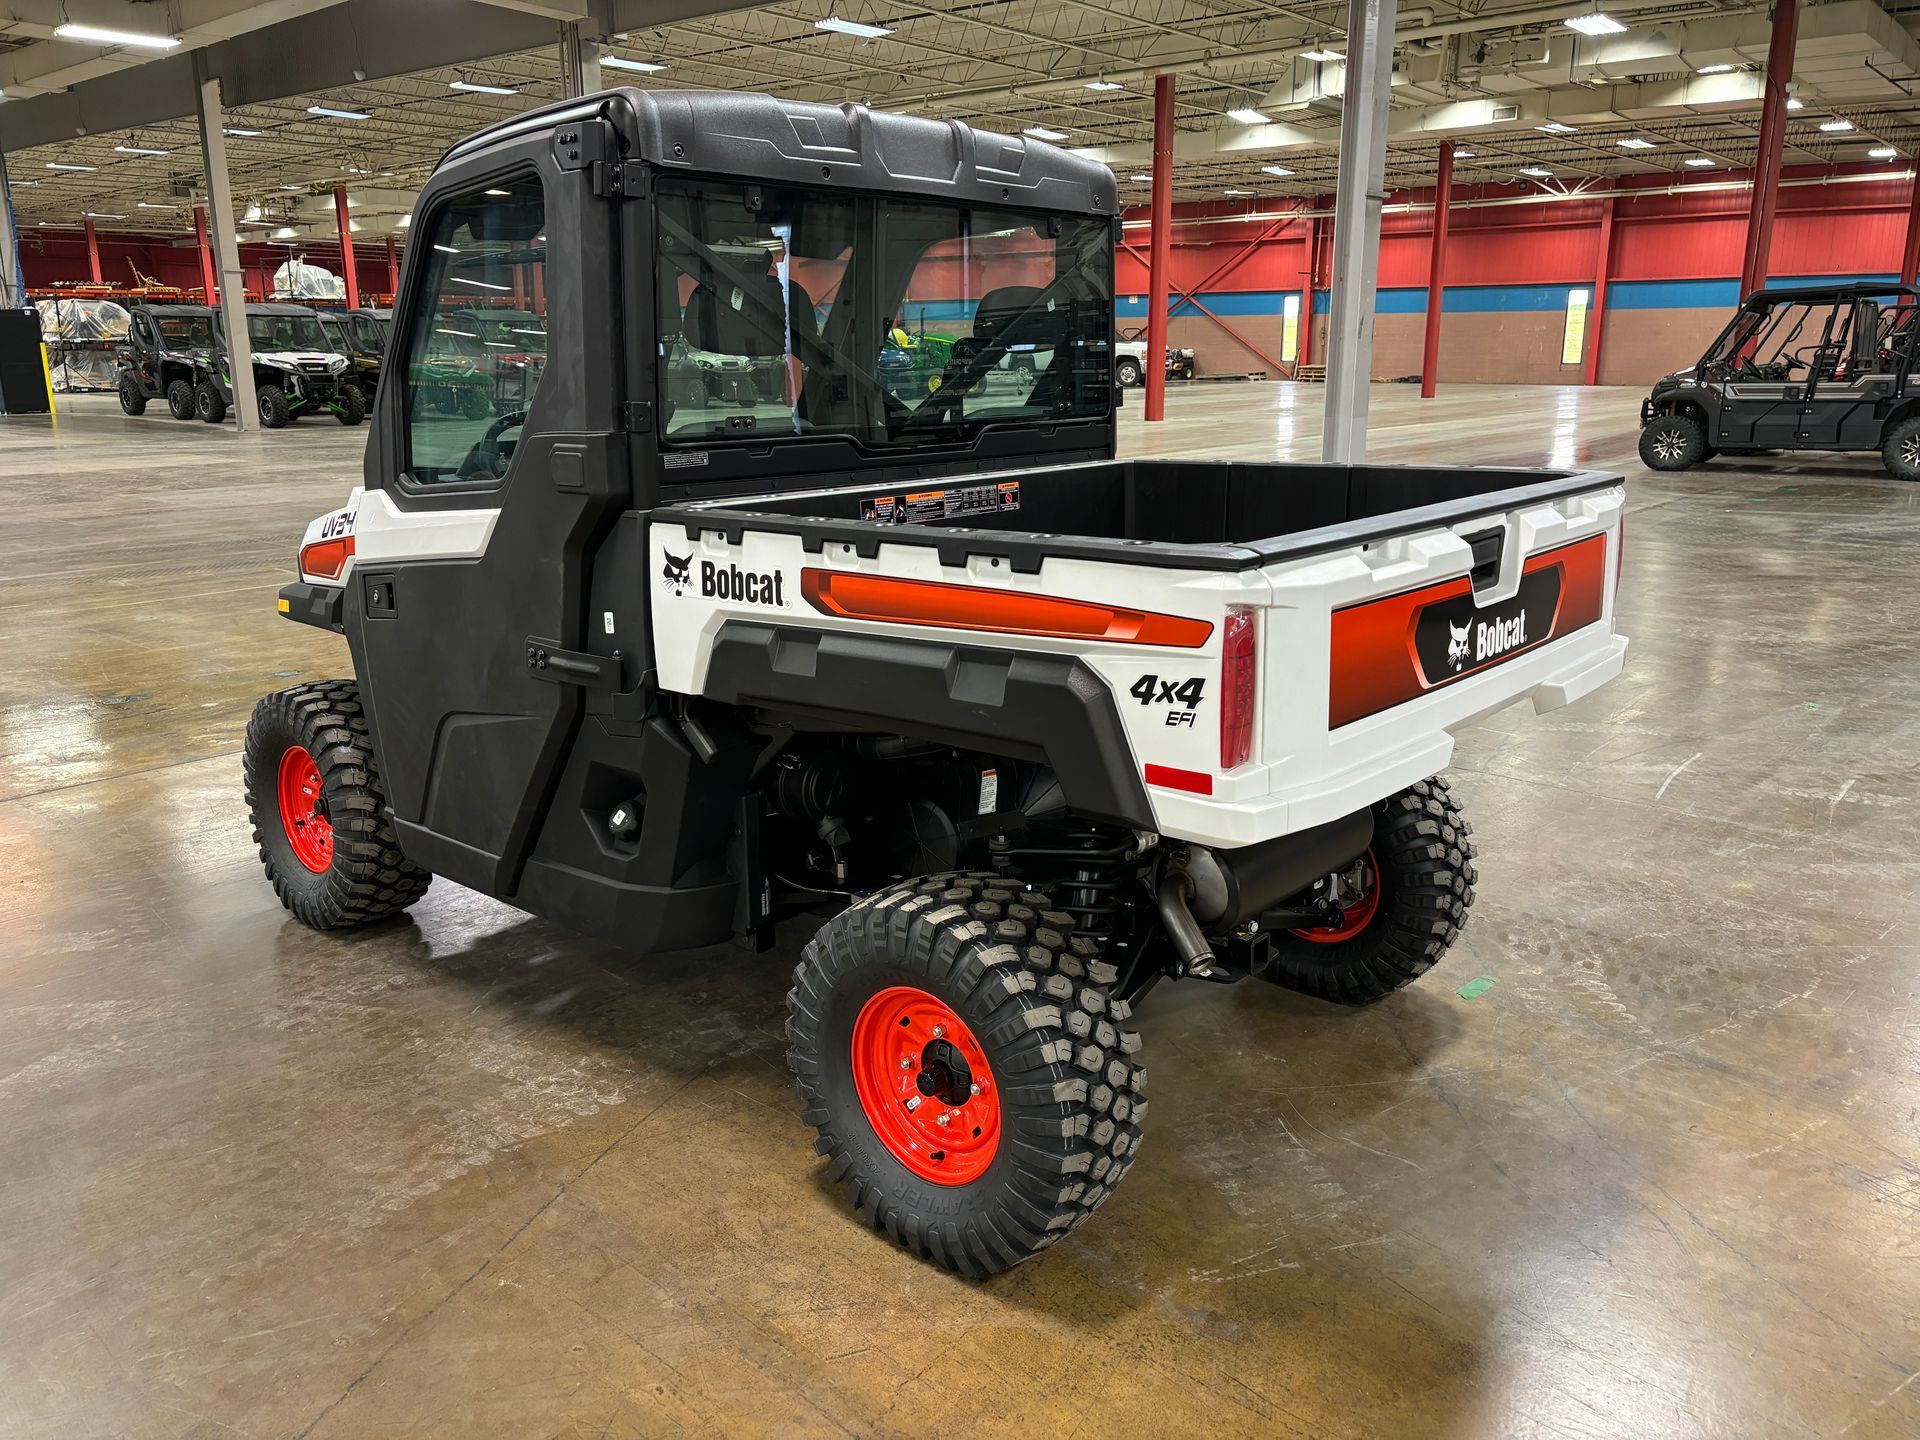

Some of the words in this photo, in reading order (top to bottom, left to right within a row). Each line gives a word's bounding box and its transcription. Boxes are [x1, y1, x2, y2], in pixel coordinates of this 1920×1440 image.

[321, 511, 357, 538] UV34
[701, 560, 783, 606] Bobcat
[1476, 608, 1526, 661] Bobcat
[1129, 674, 1206, 709] 4x4
[1165, 711, 1197, 728] EFI
